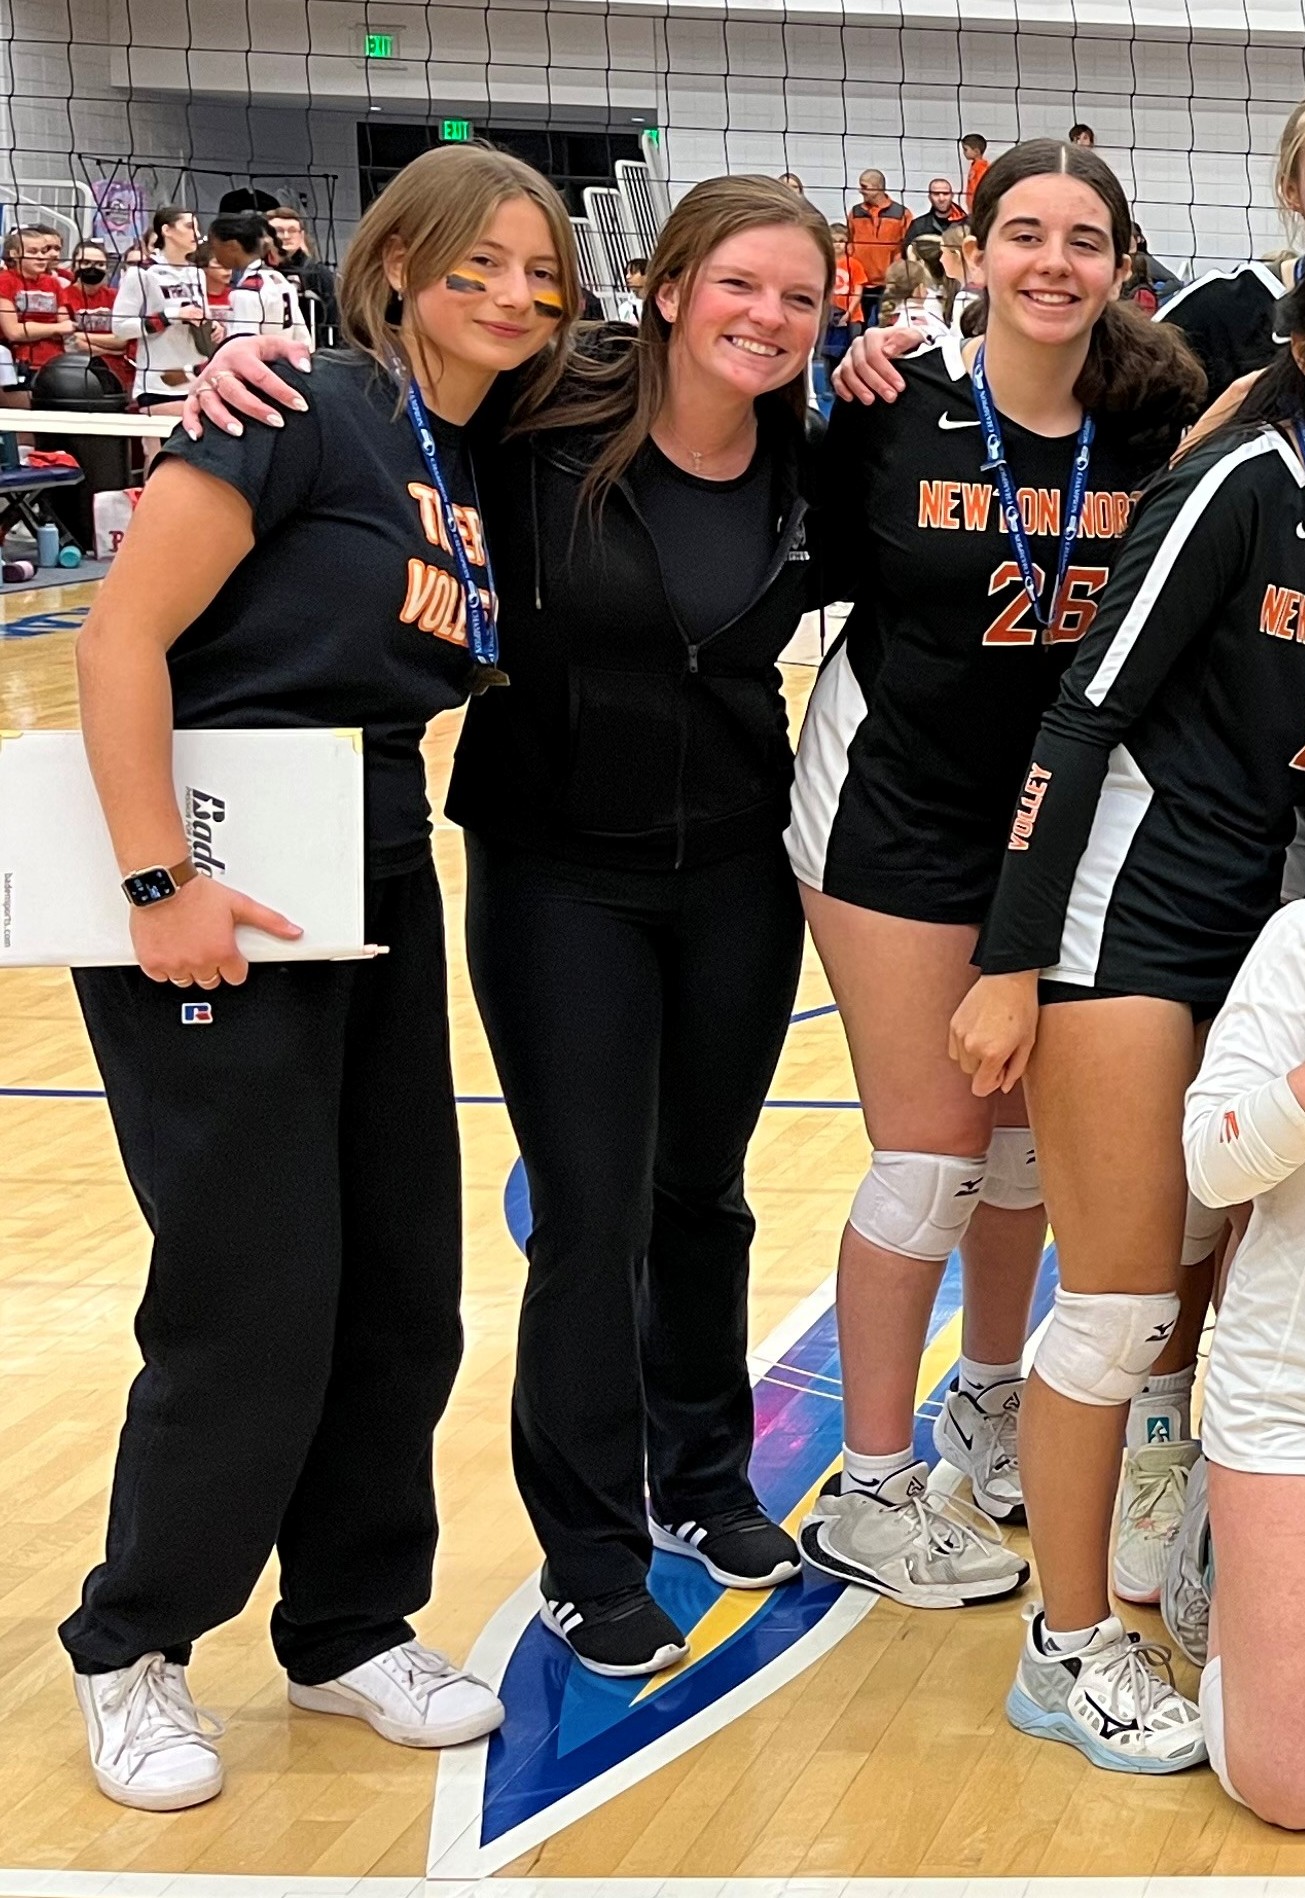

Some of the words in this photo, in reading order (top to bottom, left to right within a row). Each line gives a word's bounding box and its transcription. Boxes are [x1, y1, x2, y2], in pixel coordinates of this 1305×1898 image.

[366, 36, 392, 56] EXIT
[443, 120, 470, 140] EXIT
[982, 561, 1109, 646] 26
[1008, 762, 1053, 850] VOLLEY
